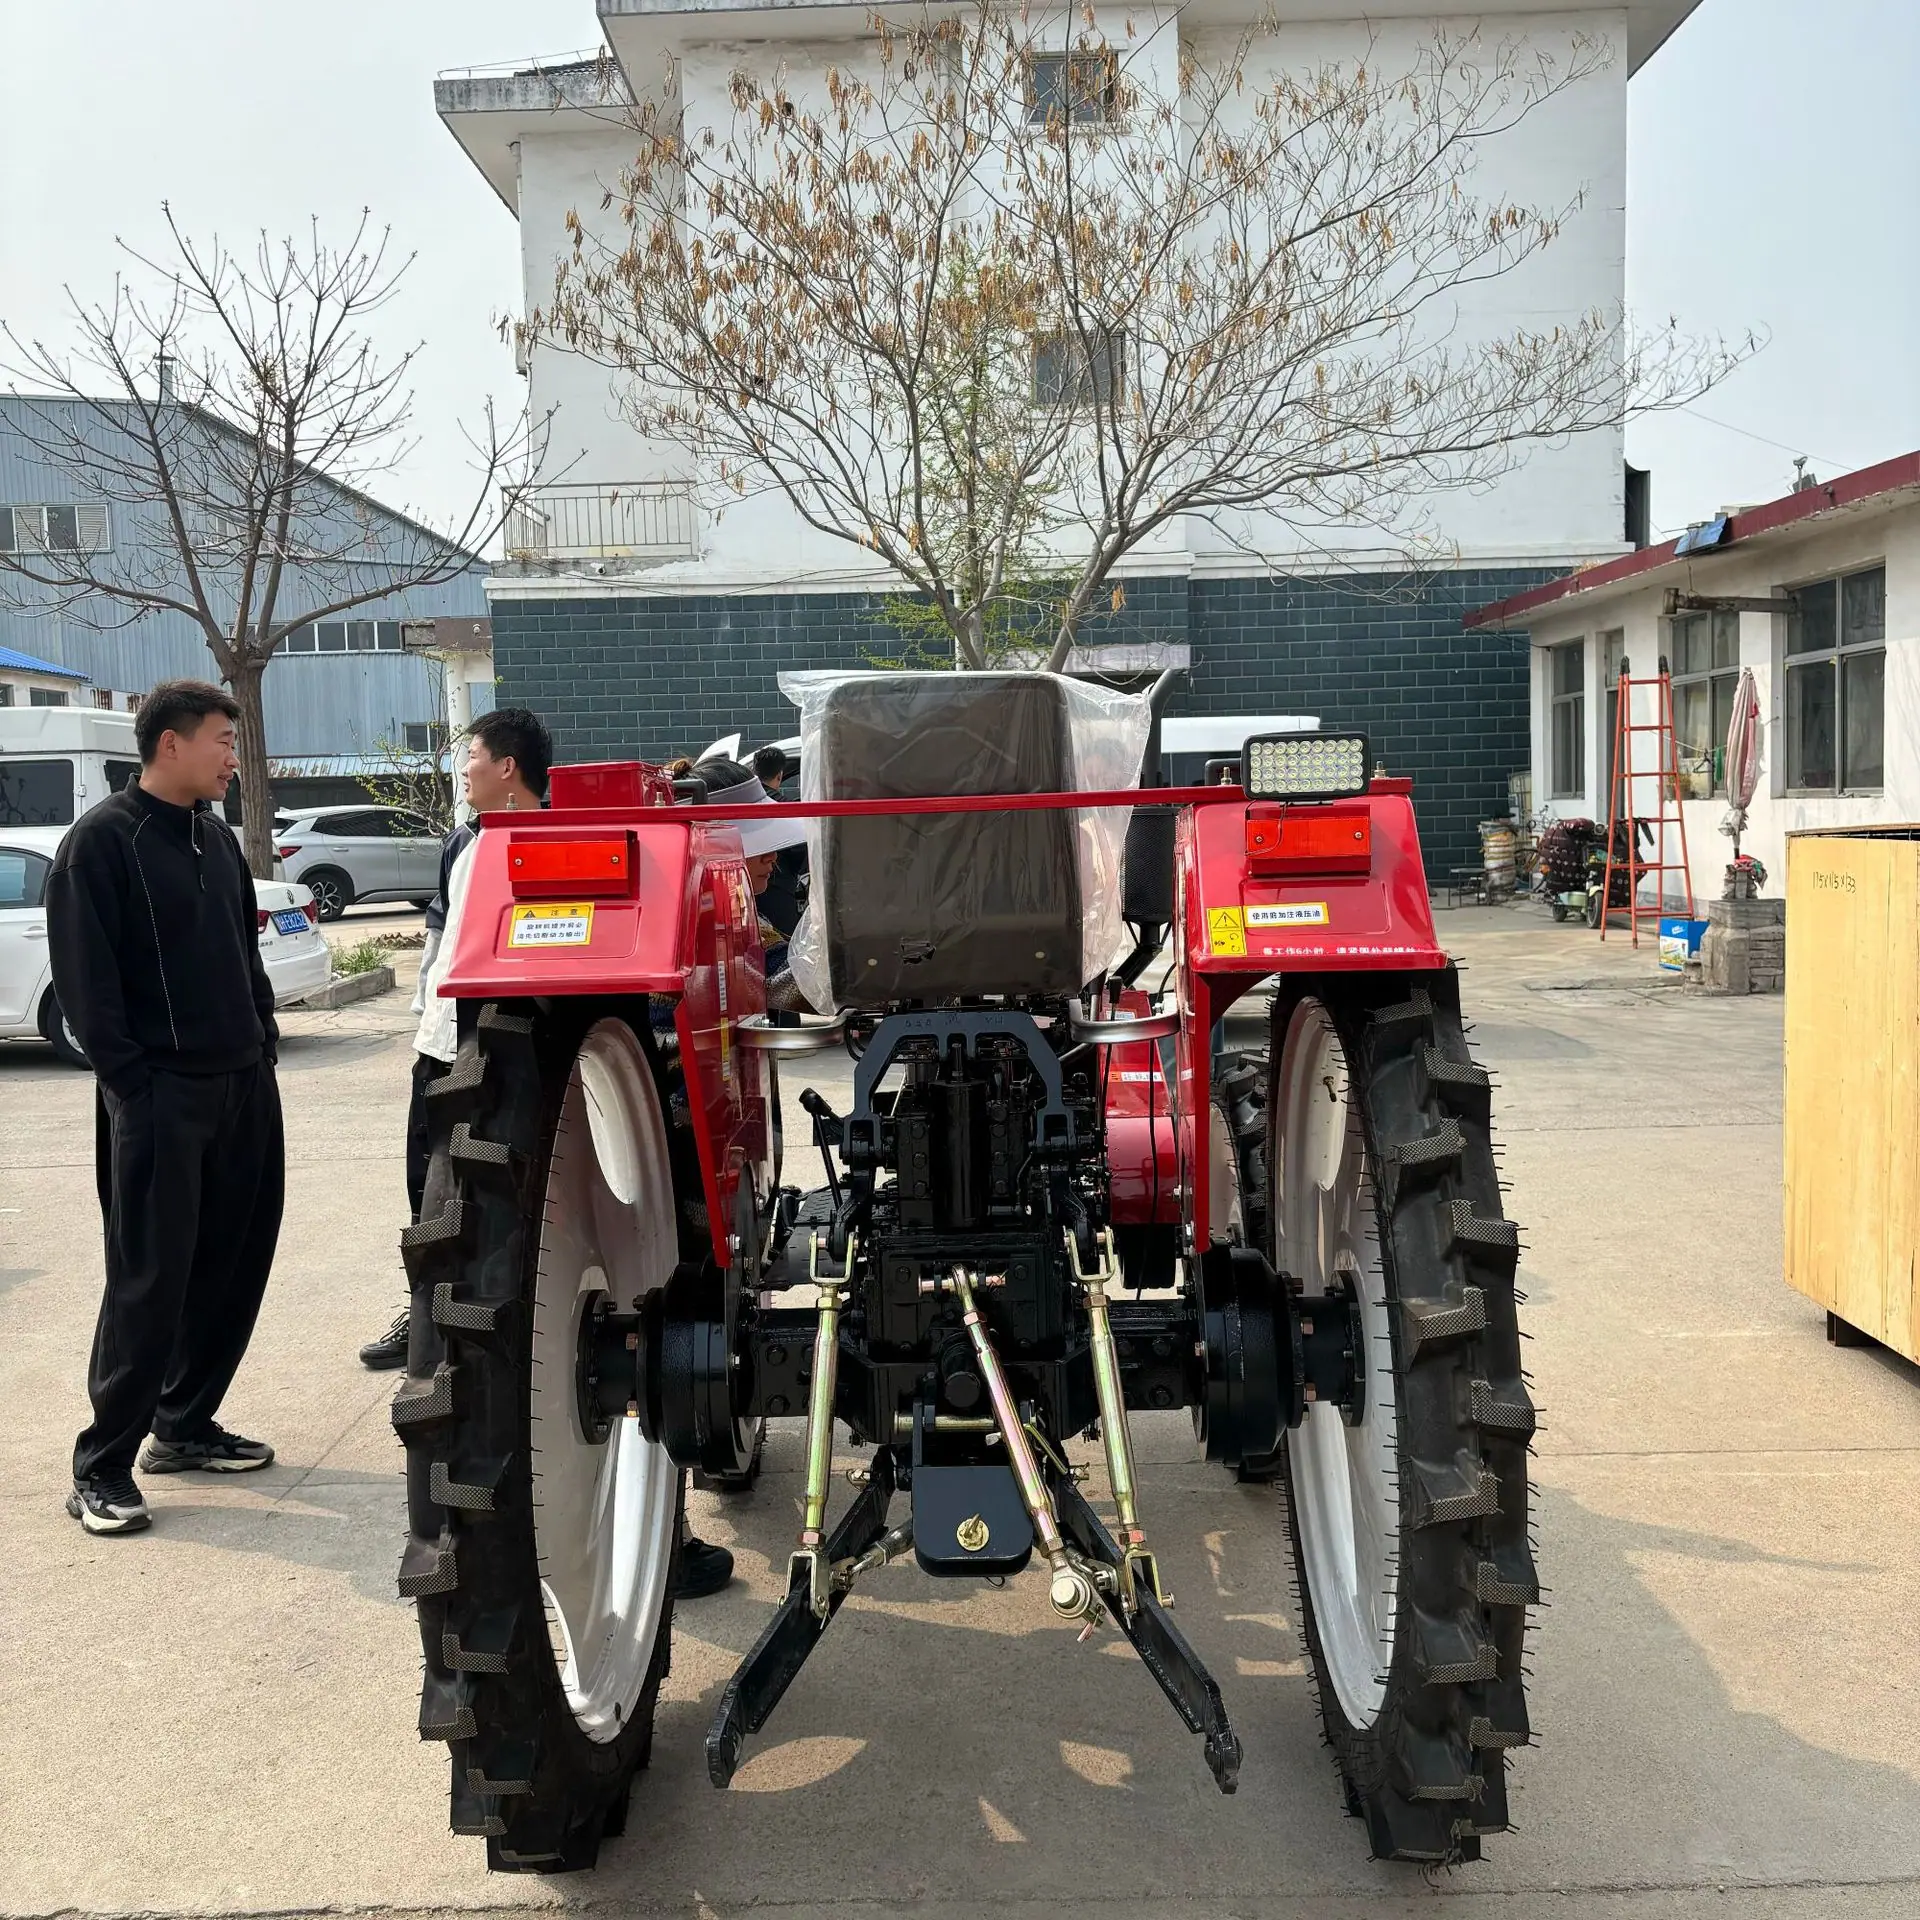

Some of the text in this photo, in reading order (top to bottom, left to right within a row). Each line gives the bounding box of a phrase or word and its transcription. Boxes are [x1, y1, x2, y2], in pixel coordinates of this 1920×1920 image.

[1252, 910, 1321, 920] 使用前加注液压油
